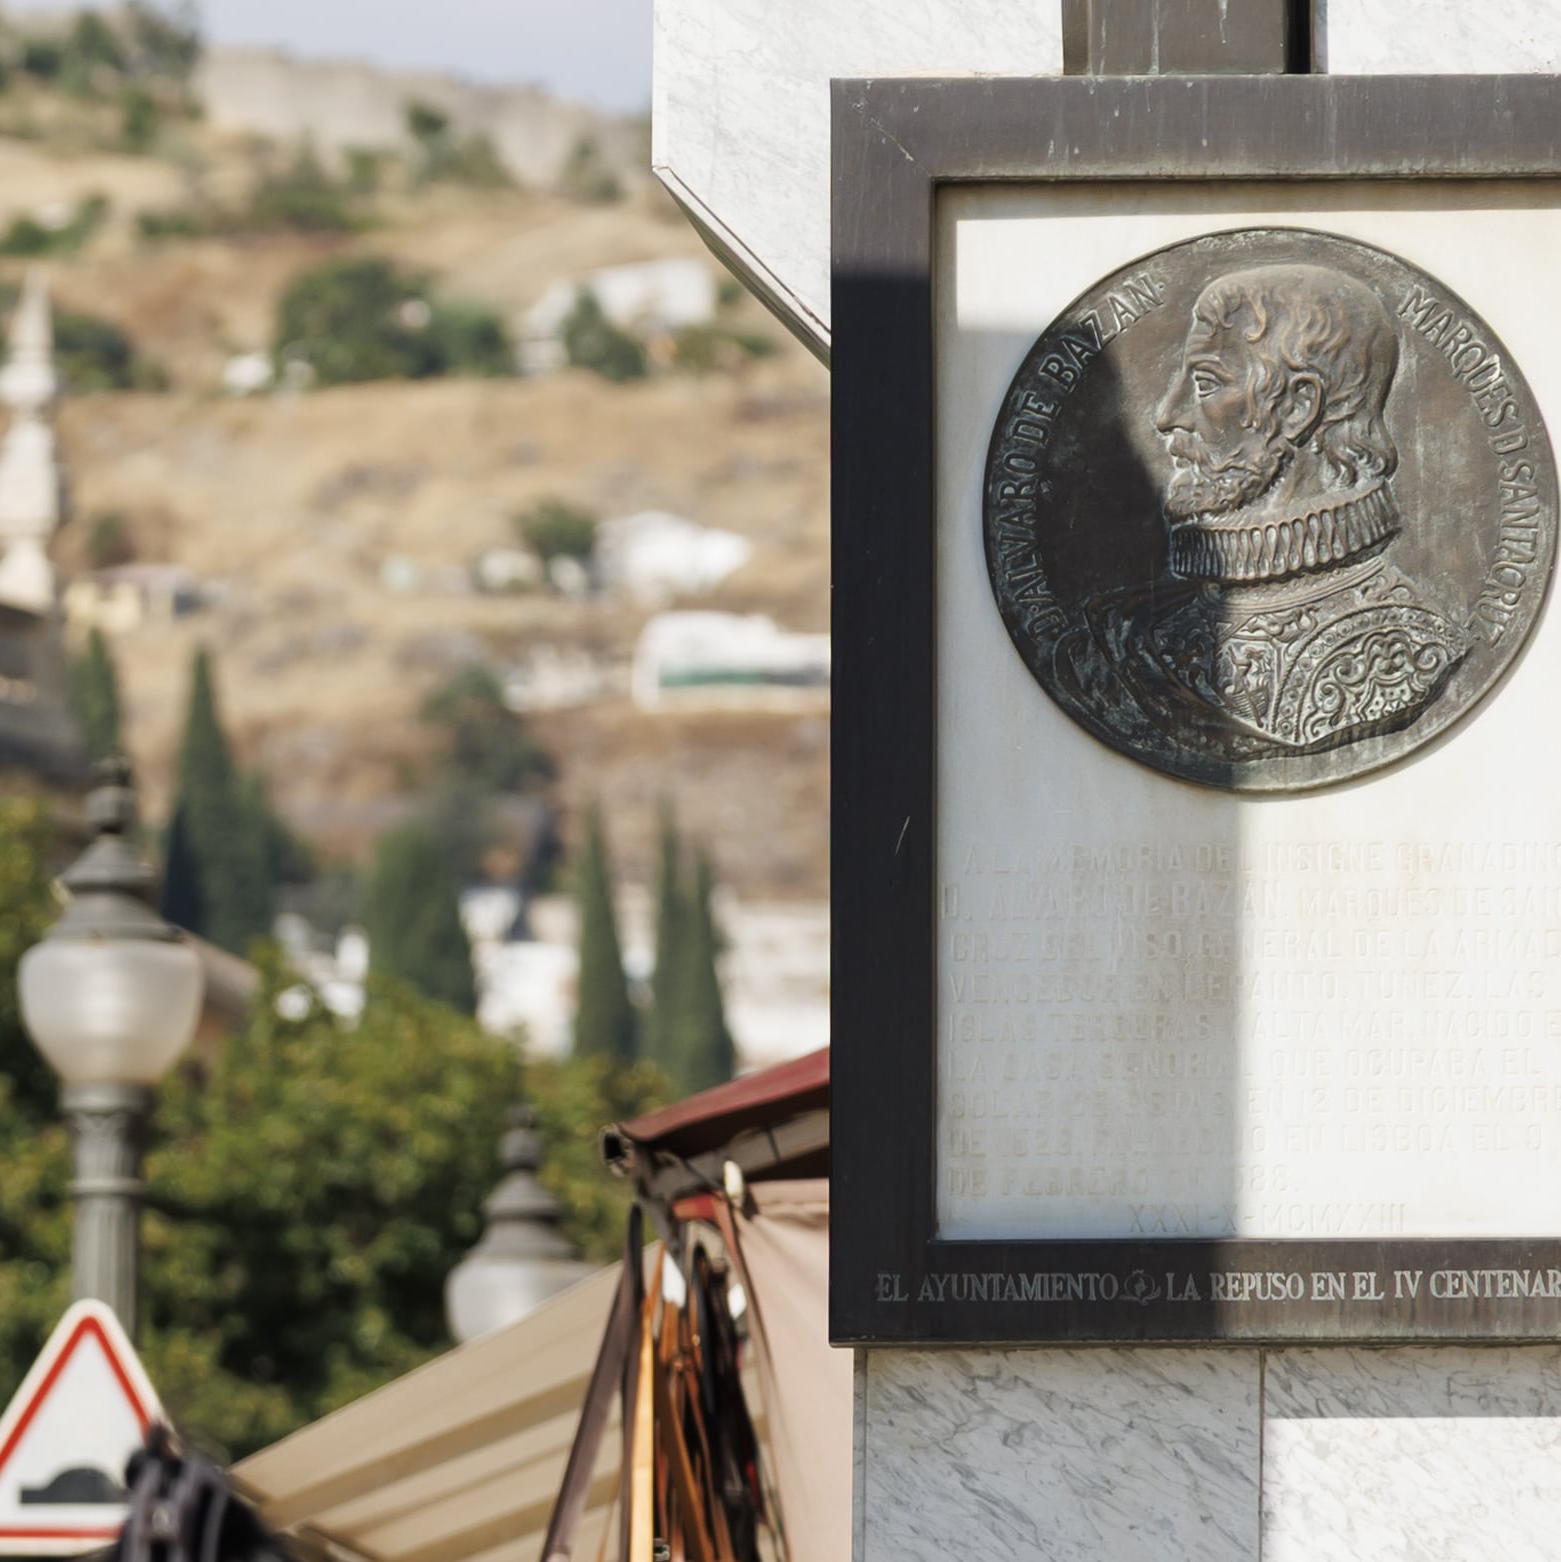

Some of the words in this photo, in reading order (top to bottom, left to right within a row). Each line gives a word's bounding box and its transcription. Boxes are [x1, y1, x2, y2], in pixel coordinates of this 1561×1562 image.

[1264, 840, 1385, 871] INSIGNE
[1484, 969, 1546, 1000] LAS
[1251, 1009, 1329, 1040] ALTA
[1344, 1046, 1487, 1079] OCUPABA
[1501, 1046, 1543, 1076] EL
[1339, 1122, 1456, 1153] LISBOA
[1469, 1122, 1511, 1152] EL
[875, 1272, 909, 1302] EL
[917, 1272, 1119, 1302] AYUNTAMIENTO
[1165, 1272, 1202, 1302] LA
[1209, 1272, 1305, 1302] REPUSO
[1310, 1272, 1346, 1301] EN
[1351, 1272, 1385, 1301] EL
[1392, 1271, 1423, 1301] IV
